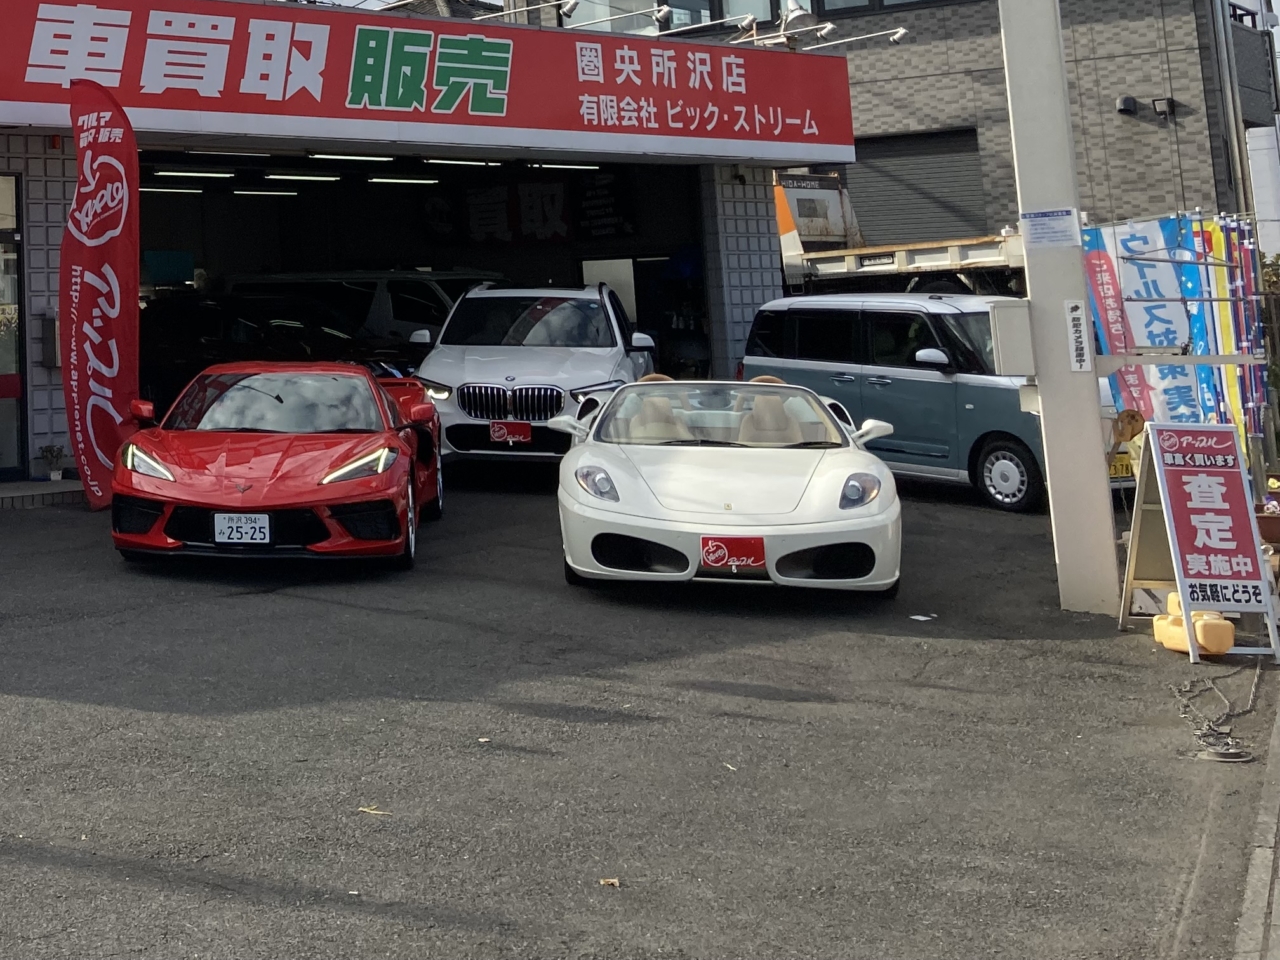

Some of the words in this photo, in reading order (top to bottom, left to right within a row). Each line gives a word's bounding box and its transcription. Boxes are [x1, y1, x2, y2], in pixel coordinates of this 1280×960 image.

[575, 41, 747, 94] 圏央所沢店
[77, 111, 113, 130] クルマ
[578, 93, 659, 129] 有限会社
[82, 262, 124, 471] アップル
[1164, 452, 1236, 468] 車高く買います
[1182, 473, 1237, 550] 査定
[227, 525, 266, 540] 25-25
[1185, 553, 1253, 577] 実施中
[1188, 582, 1263, 604] お気軽にどうぞ
